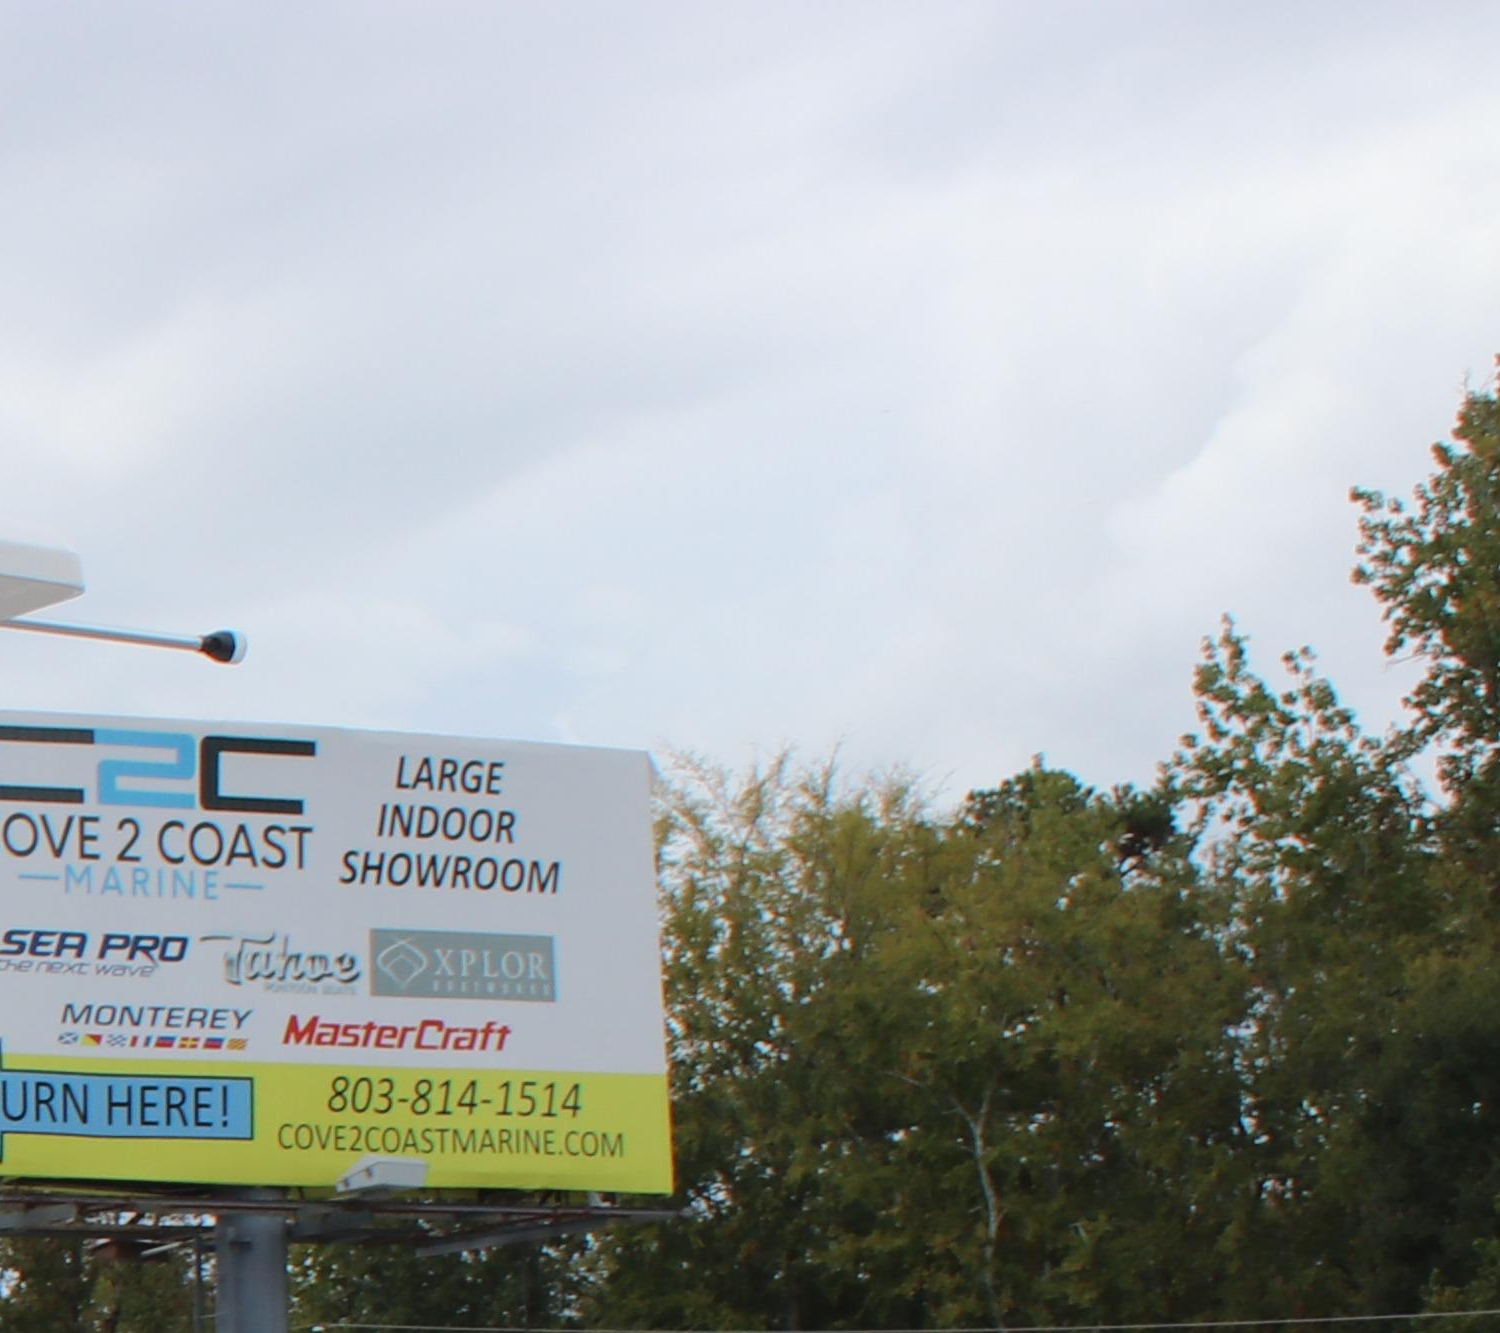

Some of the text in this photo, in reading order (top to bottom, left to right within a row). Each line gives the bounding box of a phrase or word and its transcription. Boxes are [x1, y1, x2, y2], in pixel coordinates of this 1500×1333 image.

[396, 756, 504, 795] LARGE
[378, 804, 516, 843] INDOOR
[116, 818, 142, 863] 2
[157, 820, 314, 870] COAST
[64, 863, 220, 900] MARINE
[339, 850, 560, 894] SHOWROOM
[98, 933, 189, 964] PRO
[200, 933, 363, 986] Tahoe
[433, 949, 550, 980] XPLOR
[35, 960, 92, 976] next
[94, 963, 159, 978] wave
[60, 1003, 254, 1030] MONTEREY
[282, 1015, 512, 1051] MasterCraft
[106, 1085, 229, 1128] HERE!
[327, 1075, 583, 1118] 803-814-1514
[277, 1122, 625, 1158] COVE2COASTMARINE.COM
